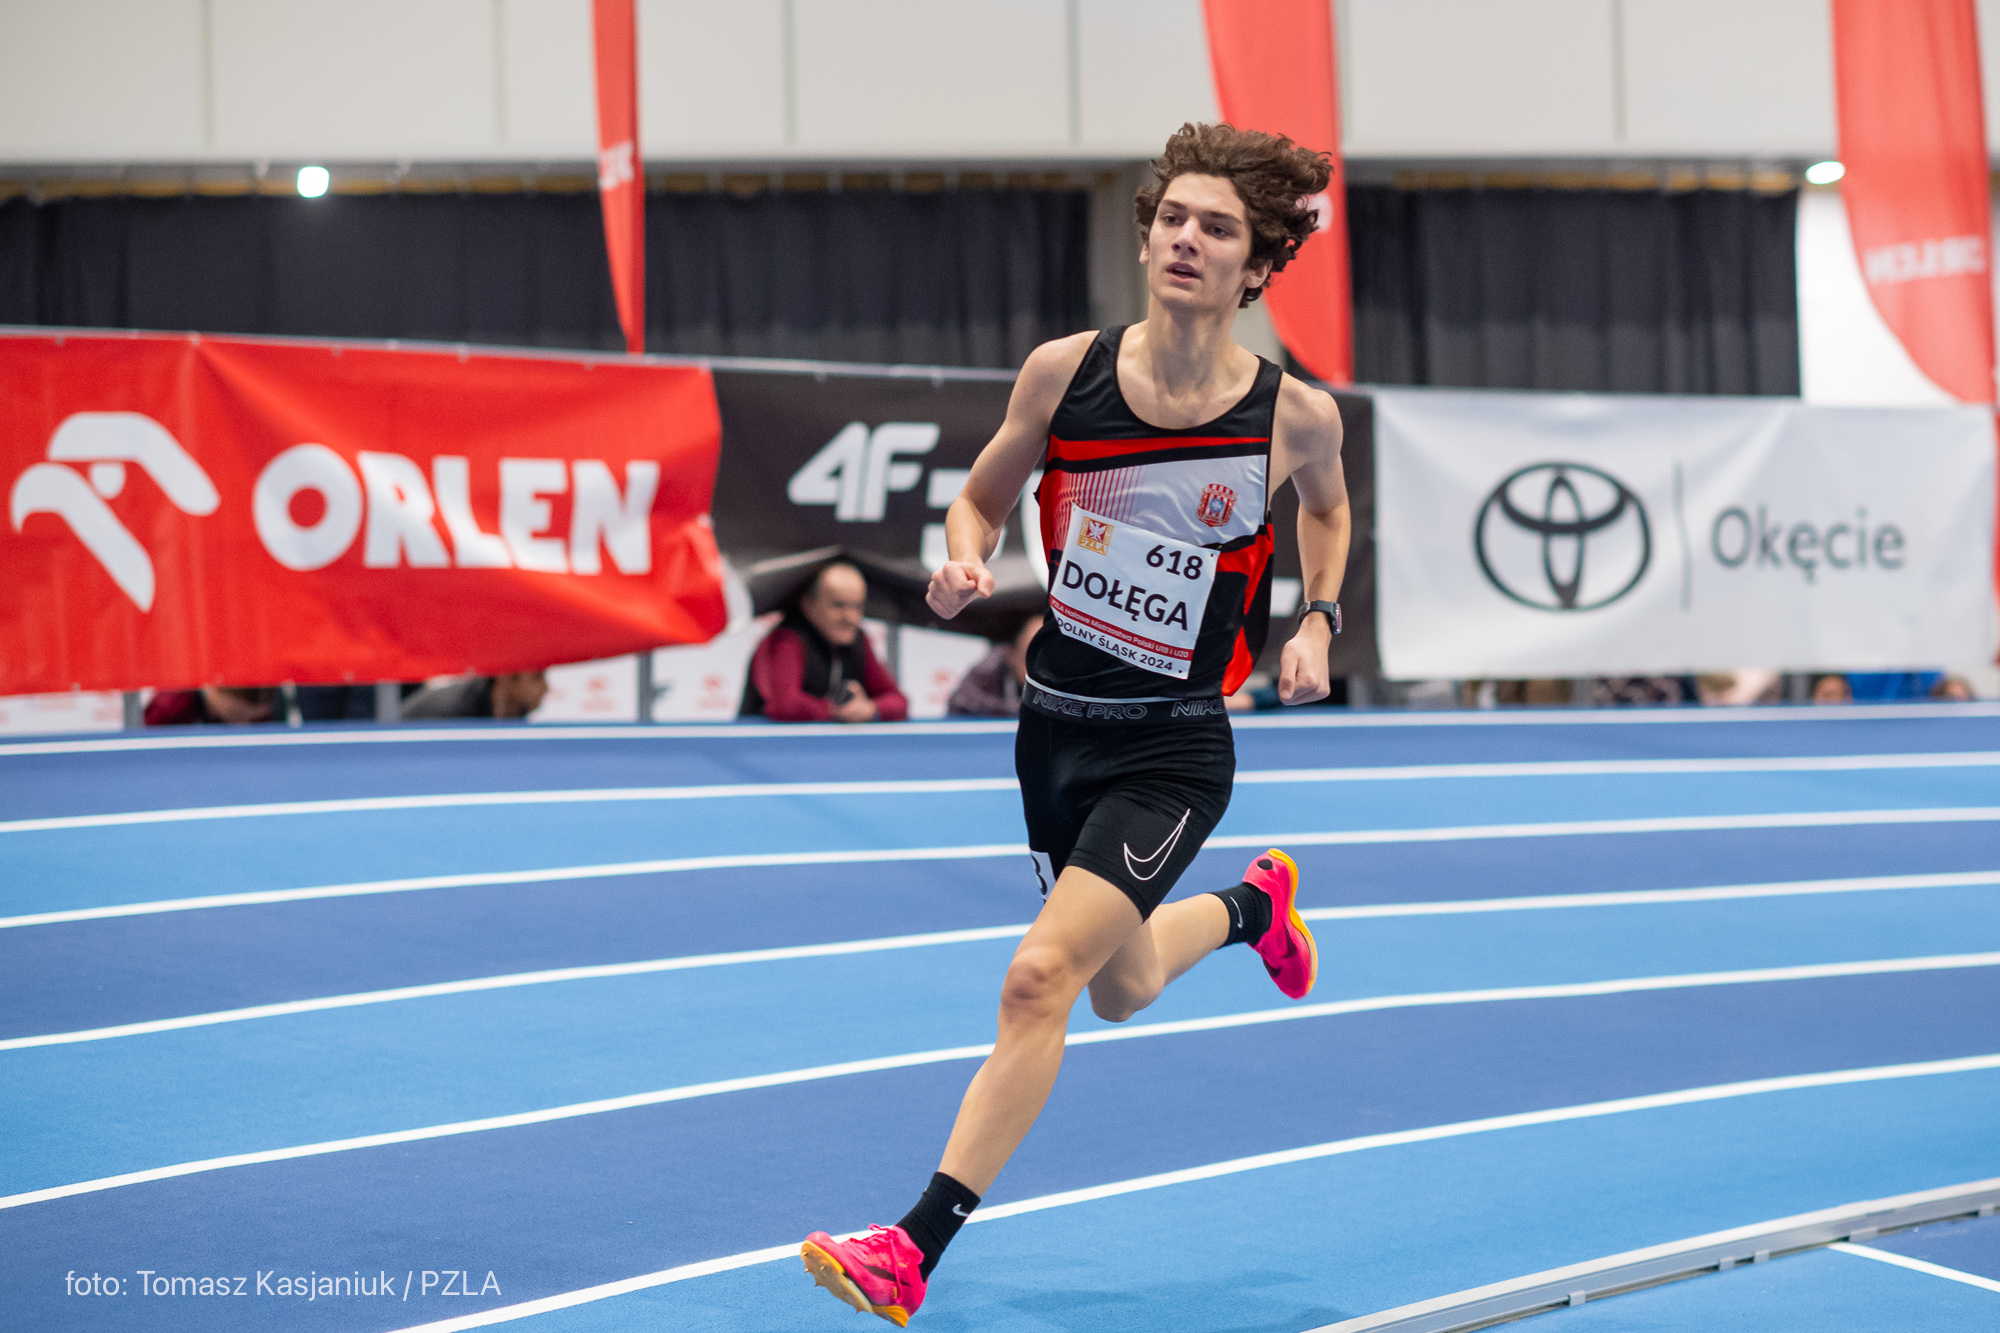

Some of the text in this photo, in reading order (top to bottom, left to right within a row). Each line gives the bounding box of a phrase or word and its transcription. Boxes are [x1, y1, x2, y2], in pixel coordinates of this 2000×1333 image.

[787, 421, 941, 522] 4F
[252, 442, 660, 575] ORLEN
[1079, 535, 1107, 554] PZLA
[1146, 544, 1203, 580] 618
[1710, 506, 1906, 584] Okęcie
[1062, 559, 1188, 631] DOŁĘGA
[1051, 599, 1065, 612] PZLA
[1065, 608, 1091, 624] Halowe
[1091, 619, 1132, 642] Mistrzostwa
[1133, 636, 1156, 650] Polski
[1155, 644, 1169, 654] U18
[1174, 650, 1189, 658] U20
[1057, 617, 1173, 671] DOLNY ŚLĄSK 2024
[1033, 690, 1087, 717] NIKE
[1086, 703, 1148, 720] PRO
